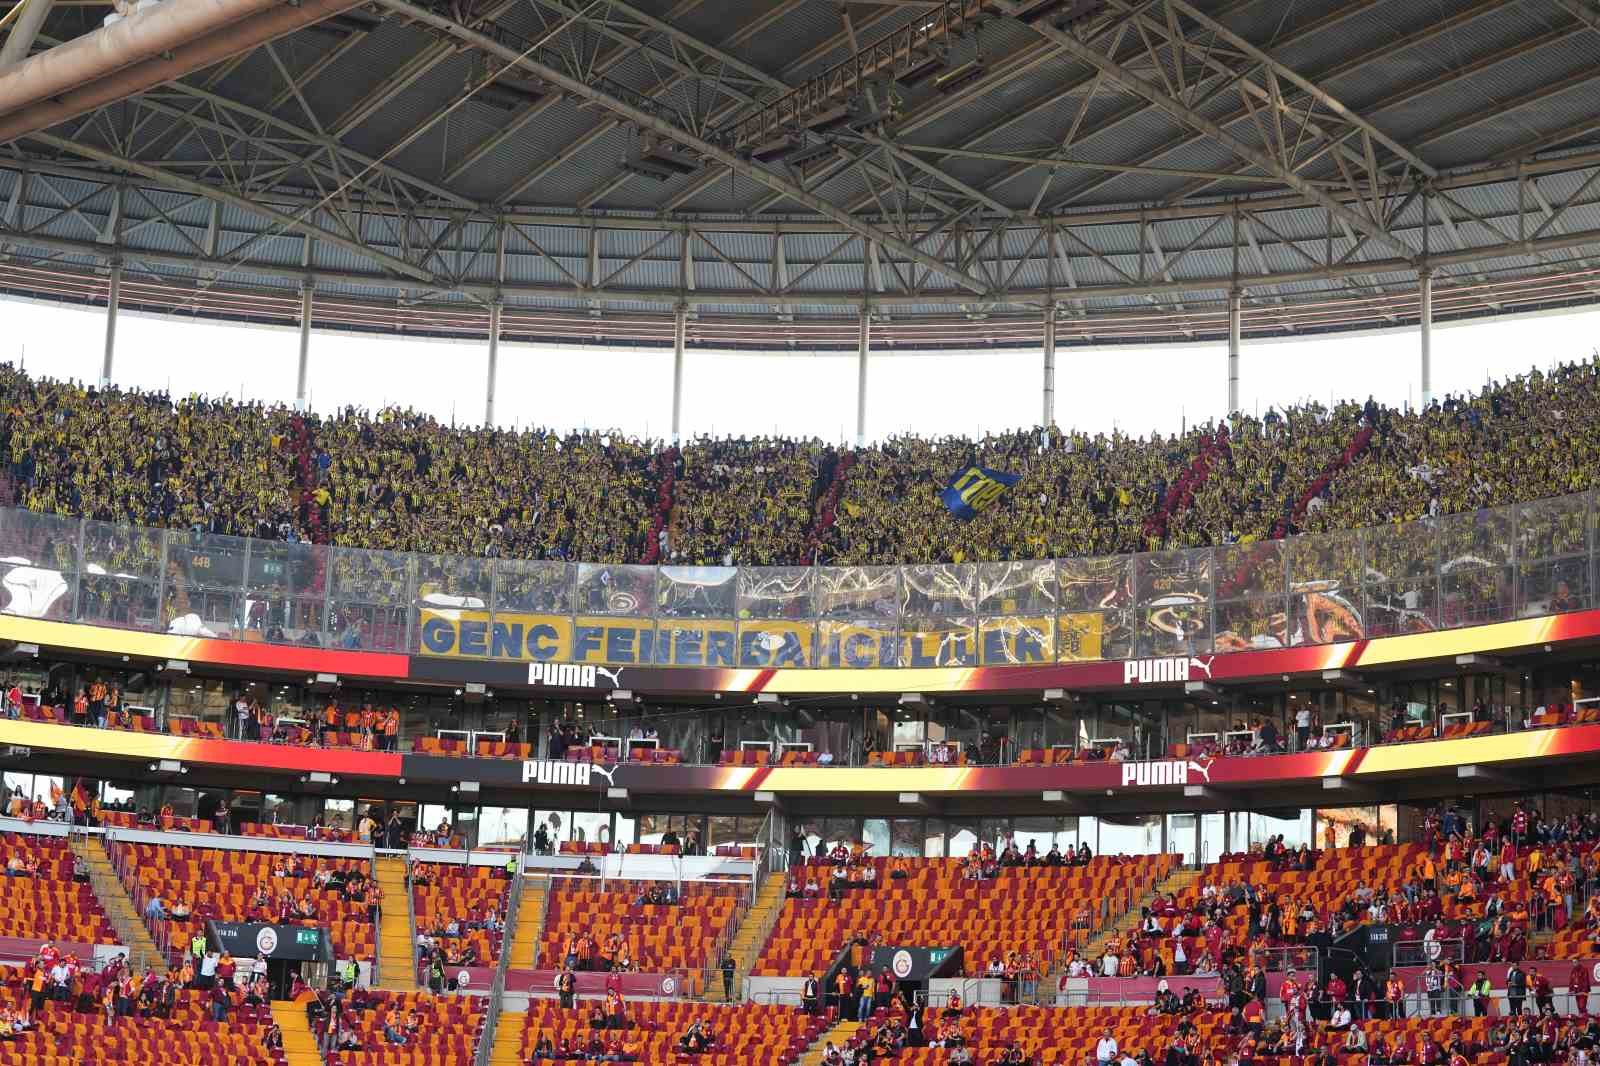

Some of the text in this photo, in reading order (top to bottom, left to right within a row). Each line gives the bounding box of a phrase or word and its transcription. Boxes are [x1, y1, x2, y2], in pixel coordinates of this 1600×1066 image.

[528, 663, 596, 687] PUMA
[1124, 657, 1189, 684] PUMA
[522, 761, 591, 785] PUMA
[1121, 760, 1188, 786] PUMA
